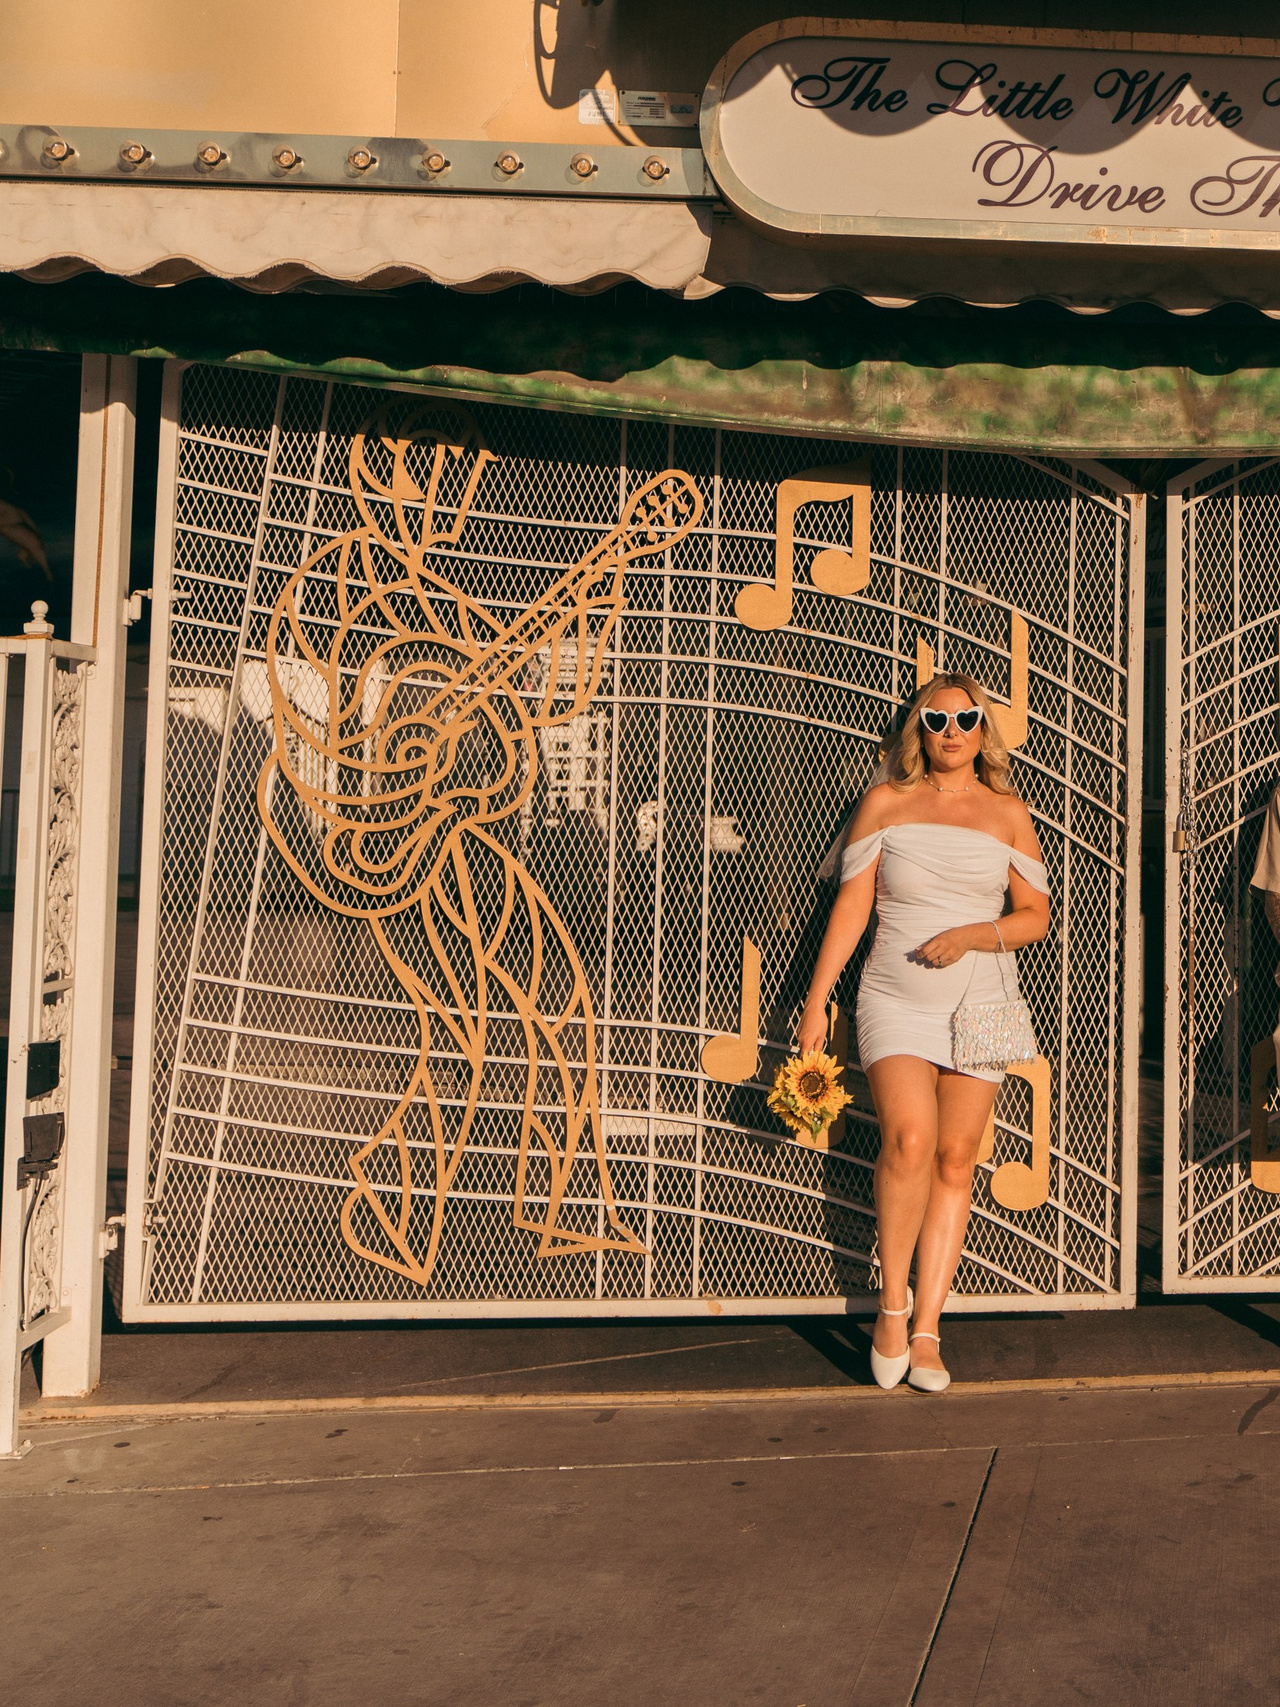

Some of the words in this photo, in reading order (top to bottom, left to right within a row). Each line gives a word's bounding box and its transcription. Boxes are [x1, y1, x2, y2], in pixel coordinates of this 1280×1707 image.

[791, 57, 908, 113] The
[927, 59, 1074, 121] Little
[1094, 68, 1243, 128] White
[972, 140, 1165, 213] Drive
